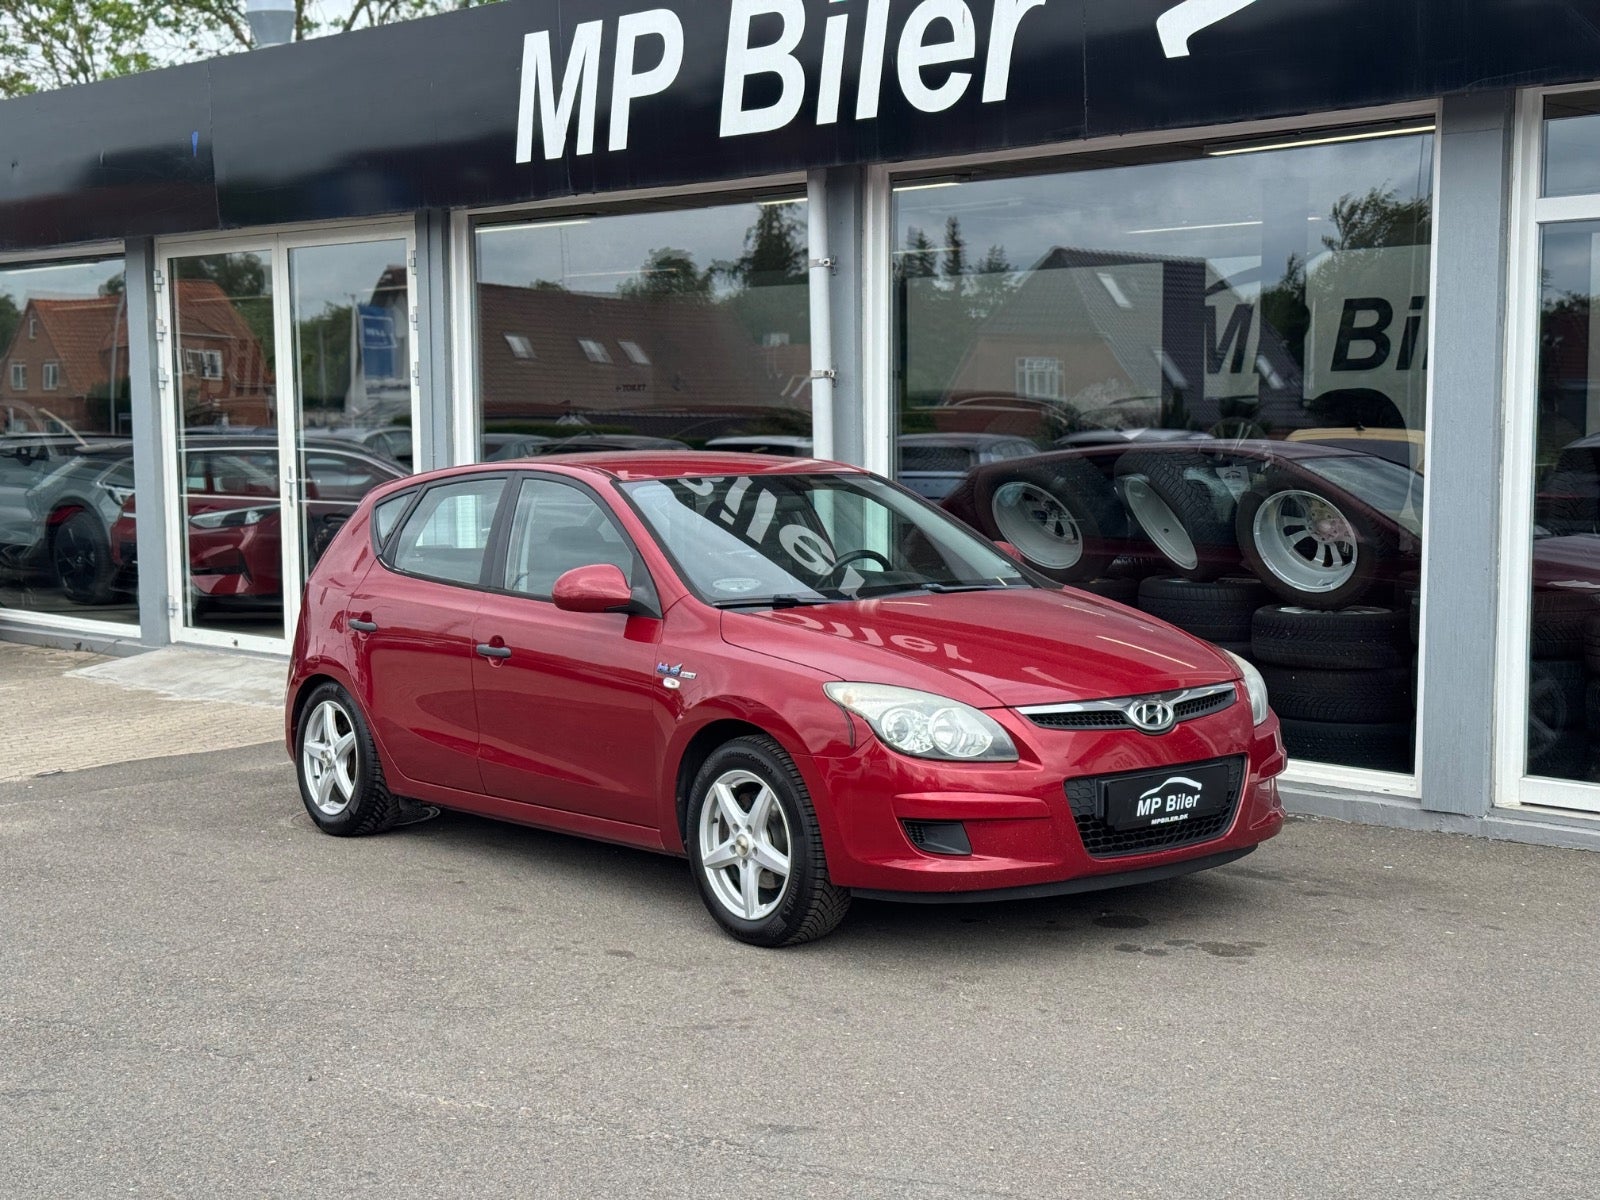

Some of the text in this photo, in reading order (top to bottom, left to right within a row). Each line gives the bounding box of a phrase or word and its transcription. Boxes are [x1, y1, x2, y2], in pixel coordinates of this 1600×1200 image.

[515, 0, 1046, 164] MP Biler
[1330, 296, 1428, 372] Bi
[1136, 793, 1201, 817] MP Biler
